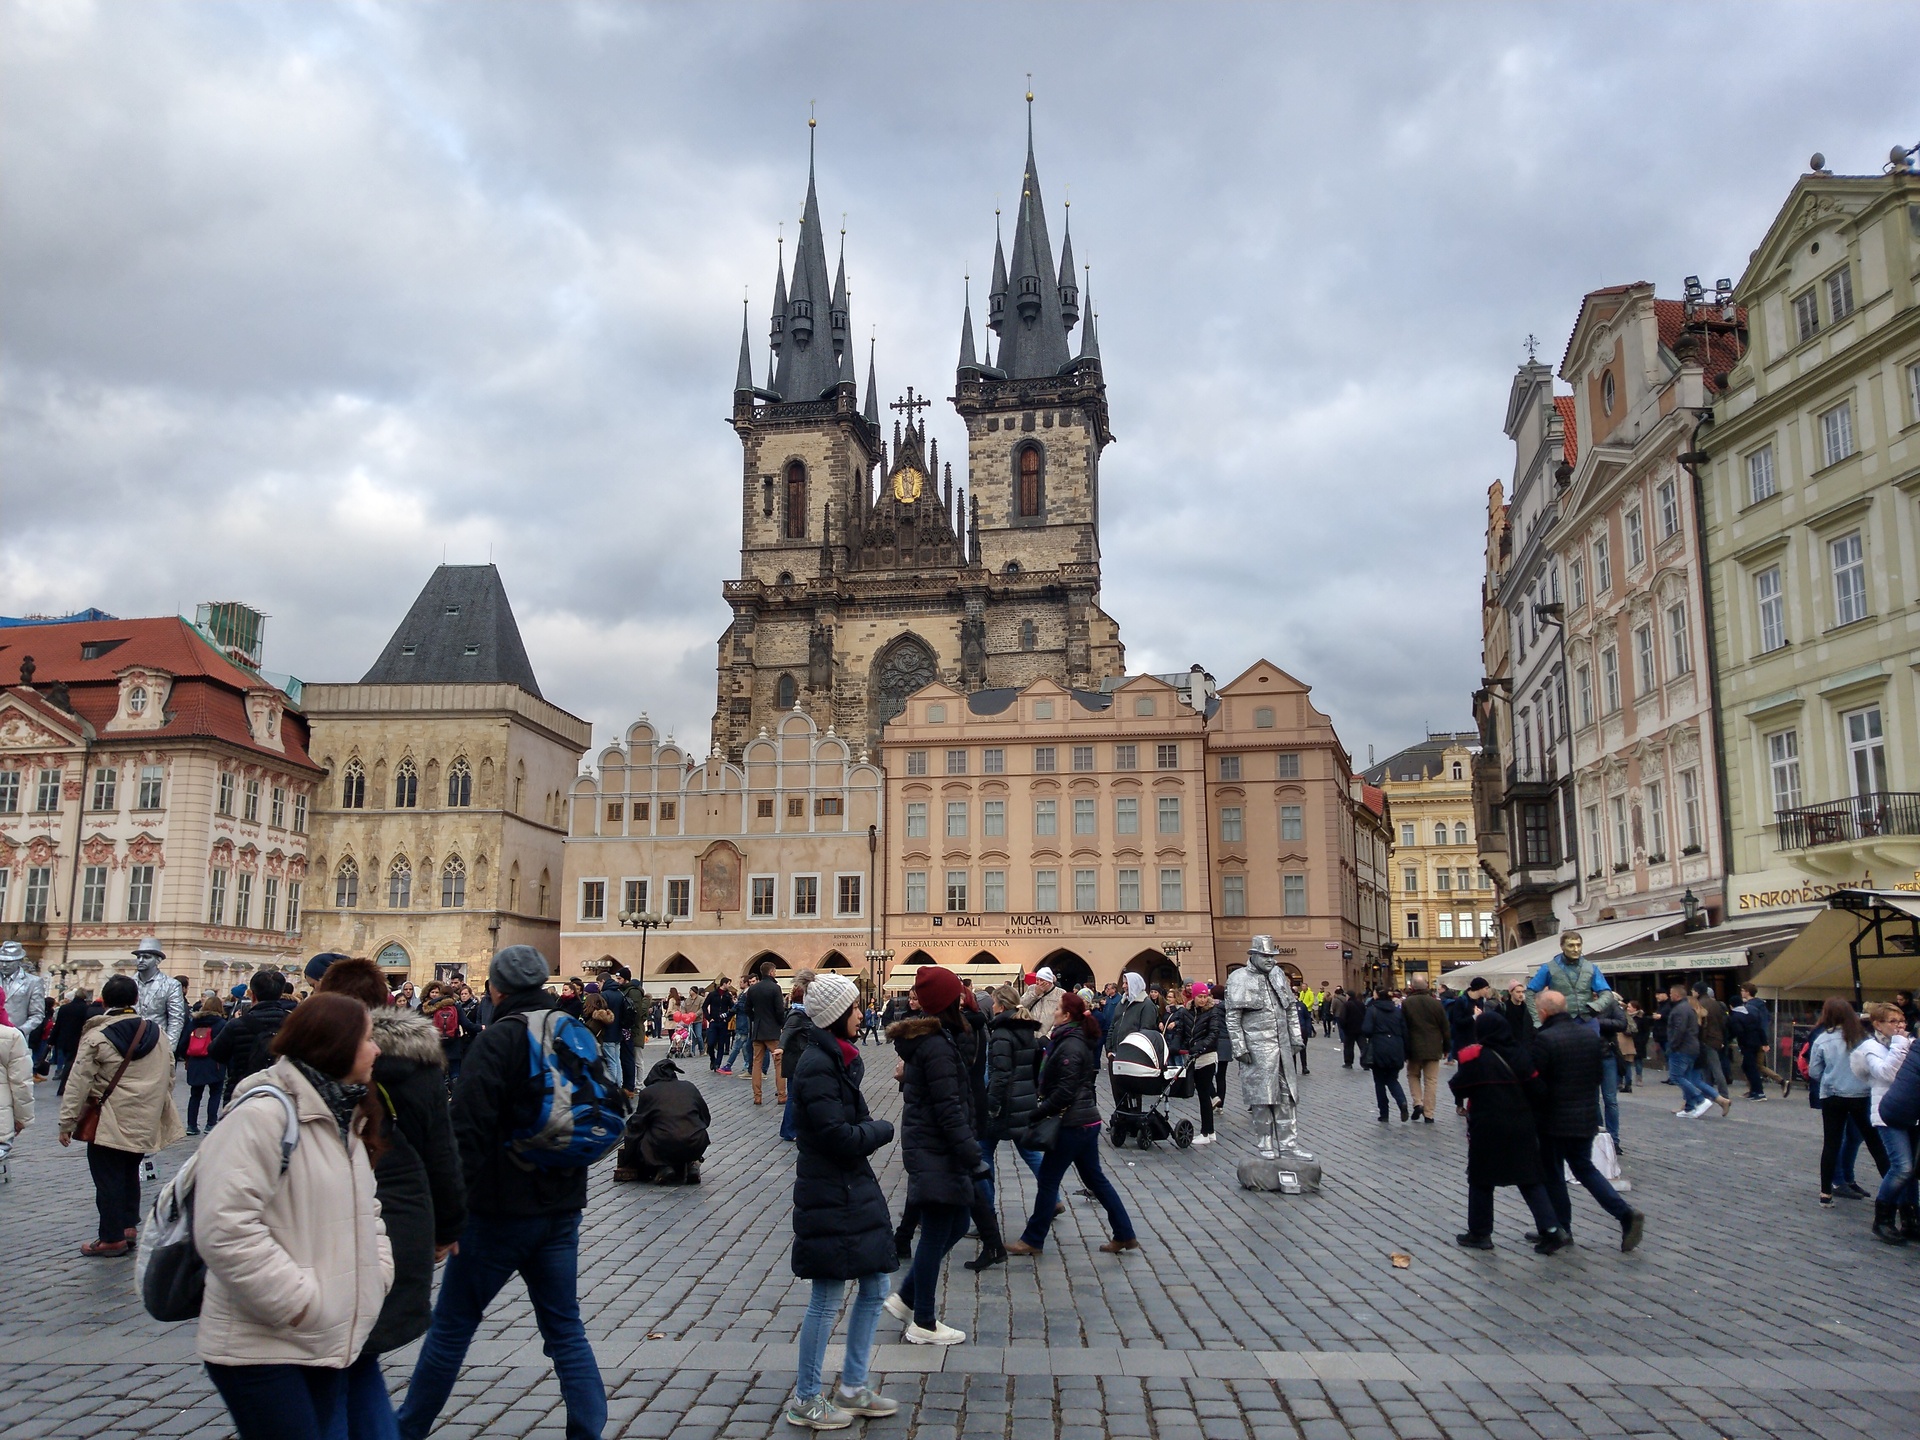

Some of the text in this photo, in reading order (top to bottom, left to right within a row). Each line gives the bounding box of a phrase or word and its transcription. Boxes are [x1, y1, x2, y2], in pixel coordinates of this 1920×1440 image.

[1010, 915, 1051, 926] MUCHA
[1082, 914, 1131, 925] WARHOL
[1005, 927, 1059, 935] exhibition
[901, 940, 955, 948] RESTAURANT
[806, 1407, 822, 1419] N
